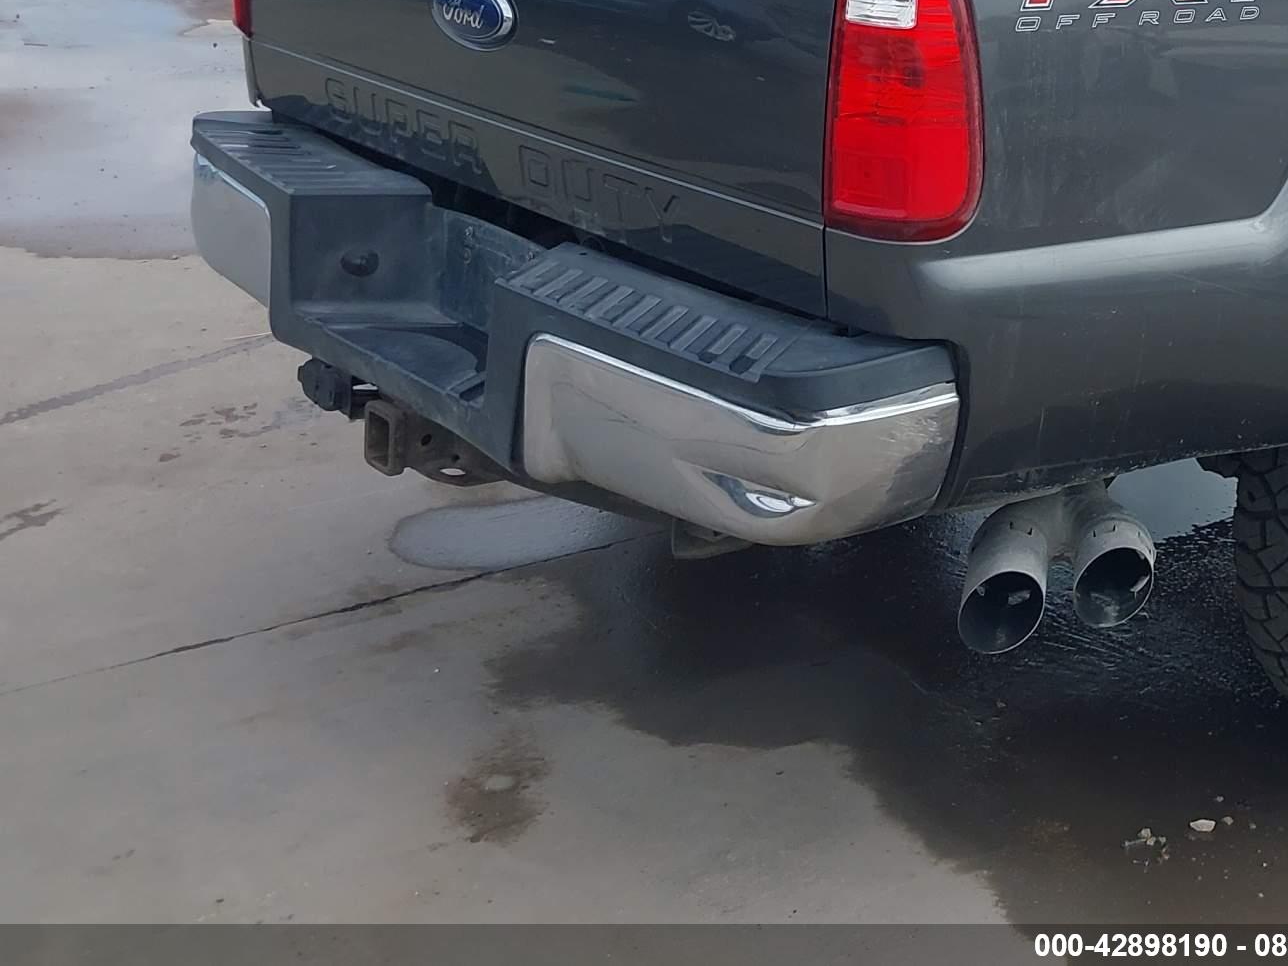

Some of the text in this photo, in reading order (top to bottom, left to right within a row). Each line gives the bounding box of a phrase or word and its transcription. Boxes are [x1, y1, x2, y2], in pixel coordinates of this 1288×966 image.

[1015, 5, 1261, 32] OFF ROAD
[325, 77, 680, 244] SUPER DUTY
